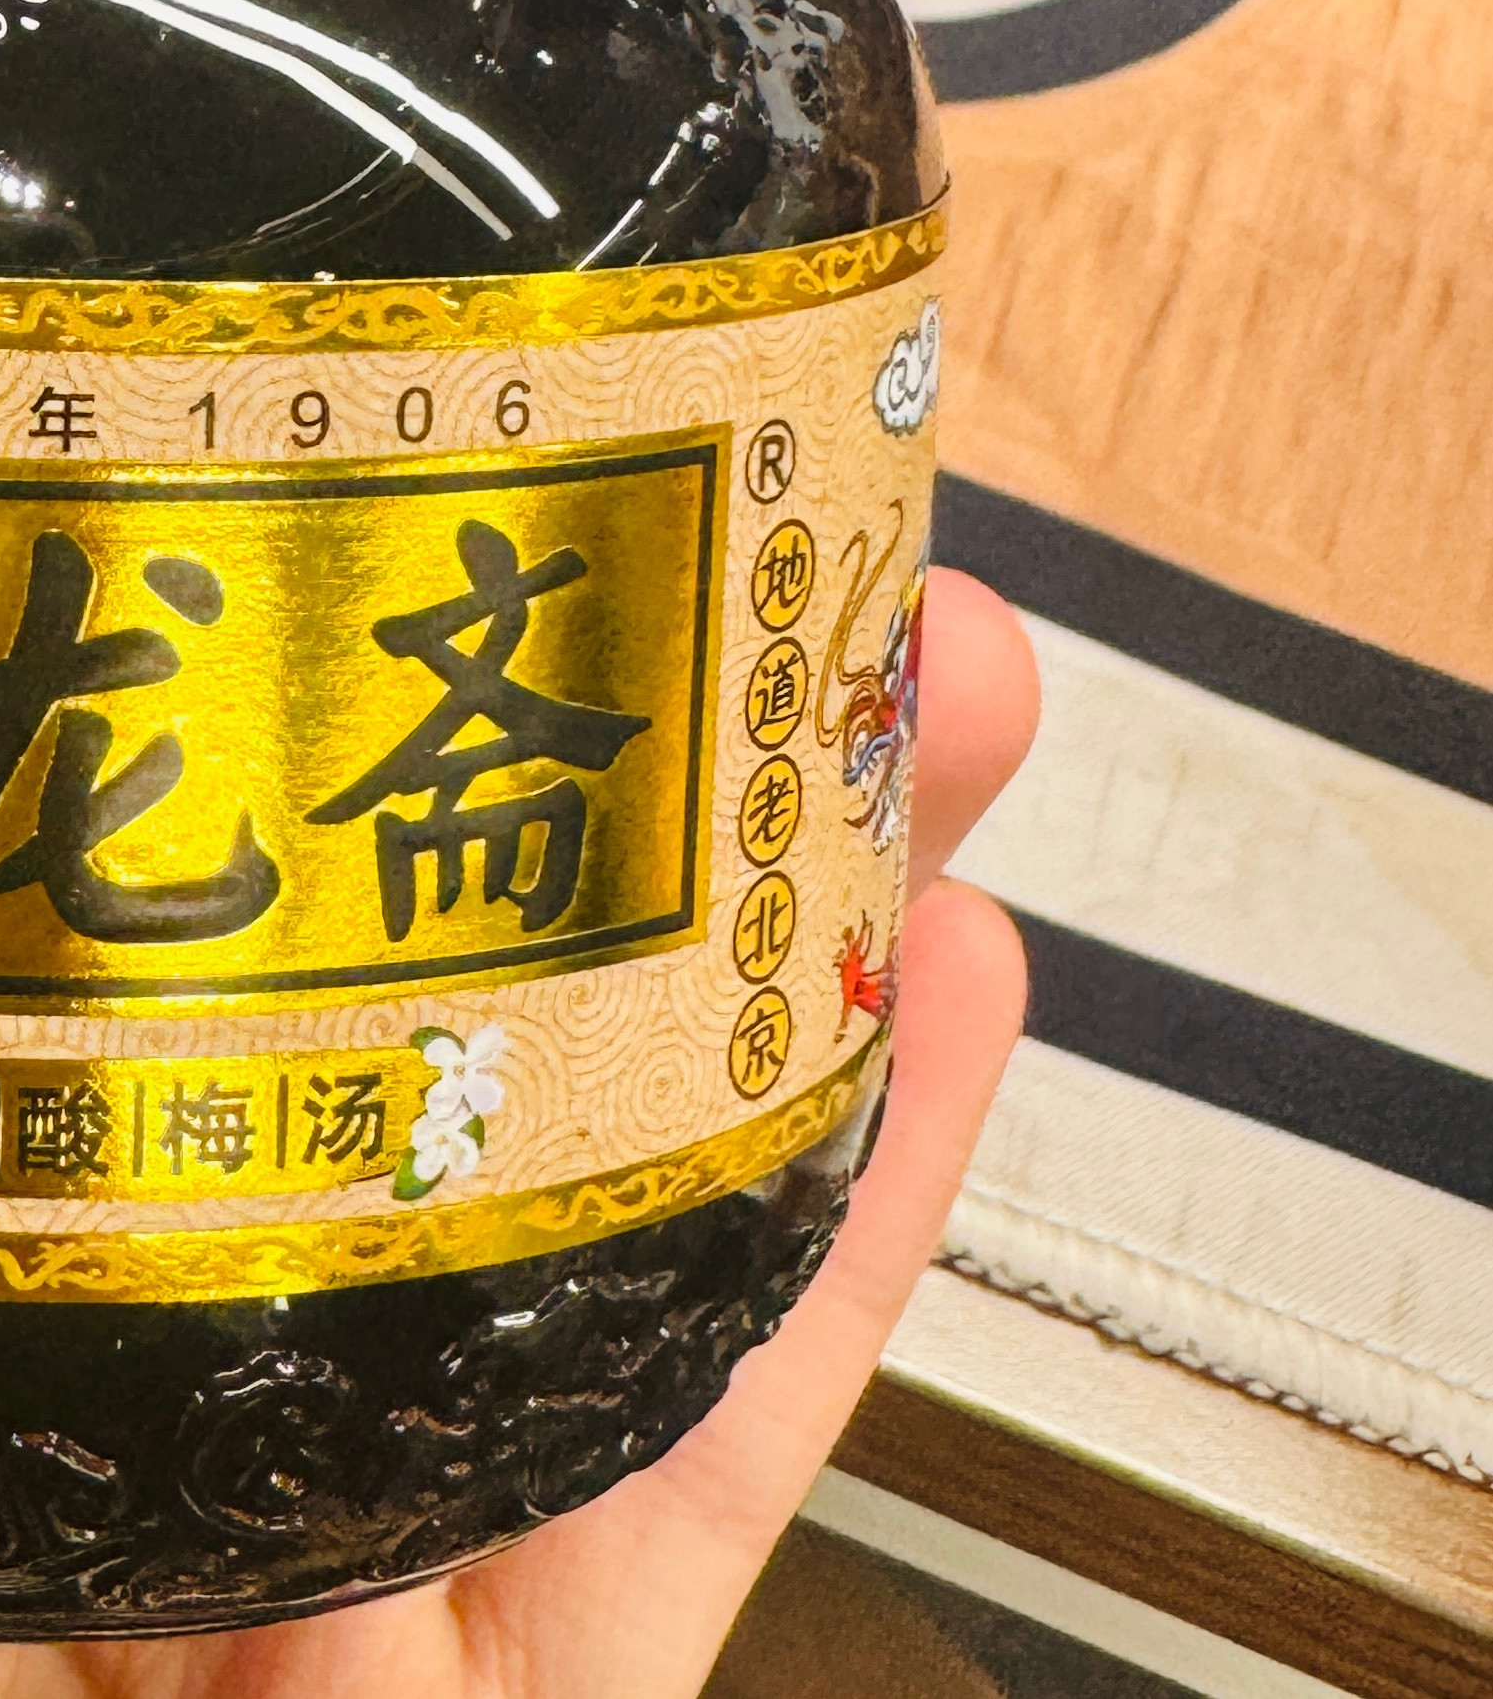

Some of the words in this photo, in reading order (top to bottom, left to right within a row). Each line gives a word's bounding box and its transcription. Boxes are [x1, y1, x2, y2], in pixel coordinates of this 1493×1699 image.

[735, 531, 809, 1089] 地道老北京
